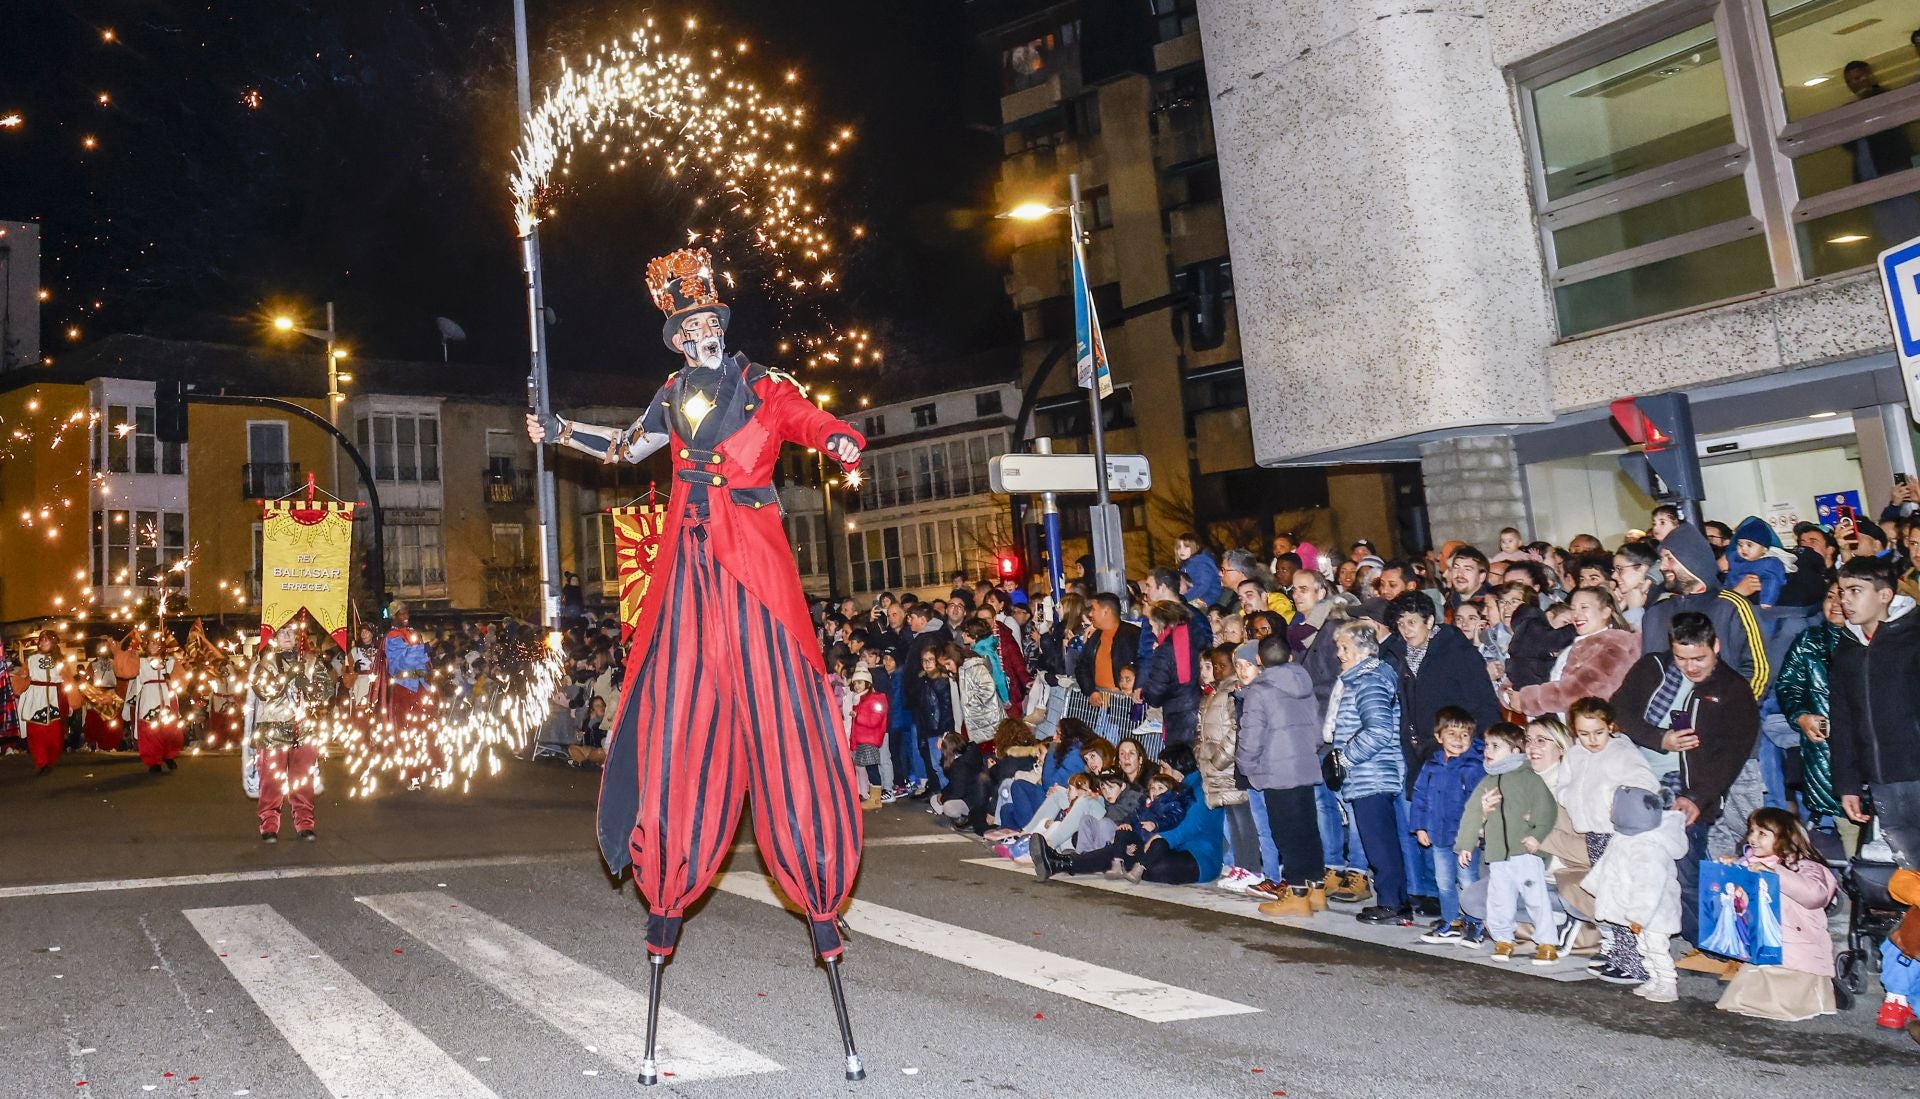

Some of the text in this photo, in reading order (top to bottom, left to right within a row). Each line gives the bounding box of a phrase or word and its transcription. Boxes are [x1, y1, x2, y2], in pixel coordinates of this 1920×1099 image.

[297, 554, 317, 563] REY
[273, 567, 341, 579] BALTASAR
[281, 582, 331, 592] ERREGEA
